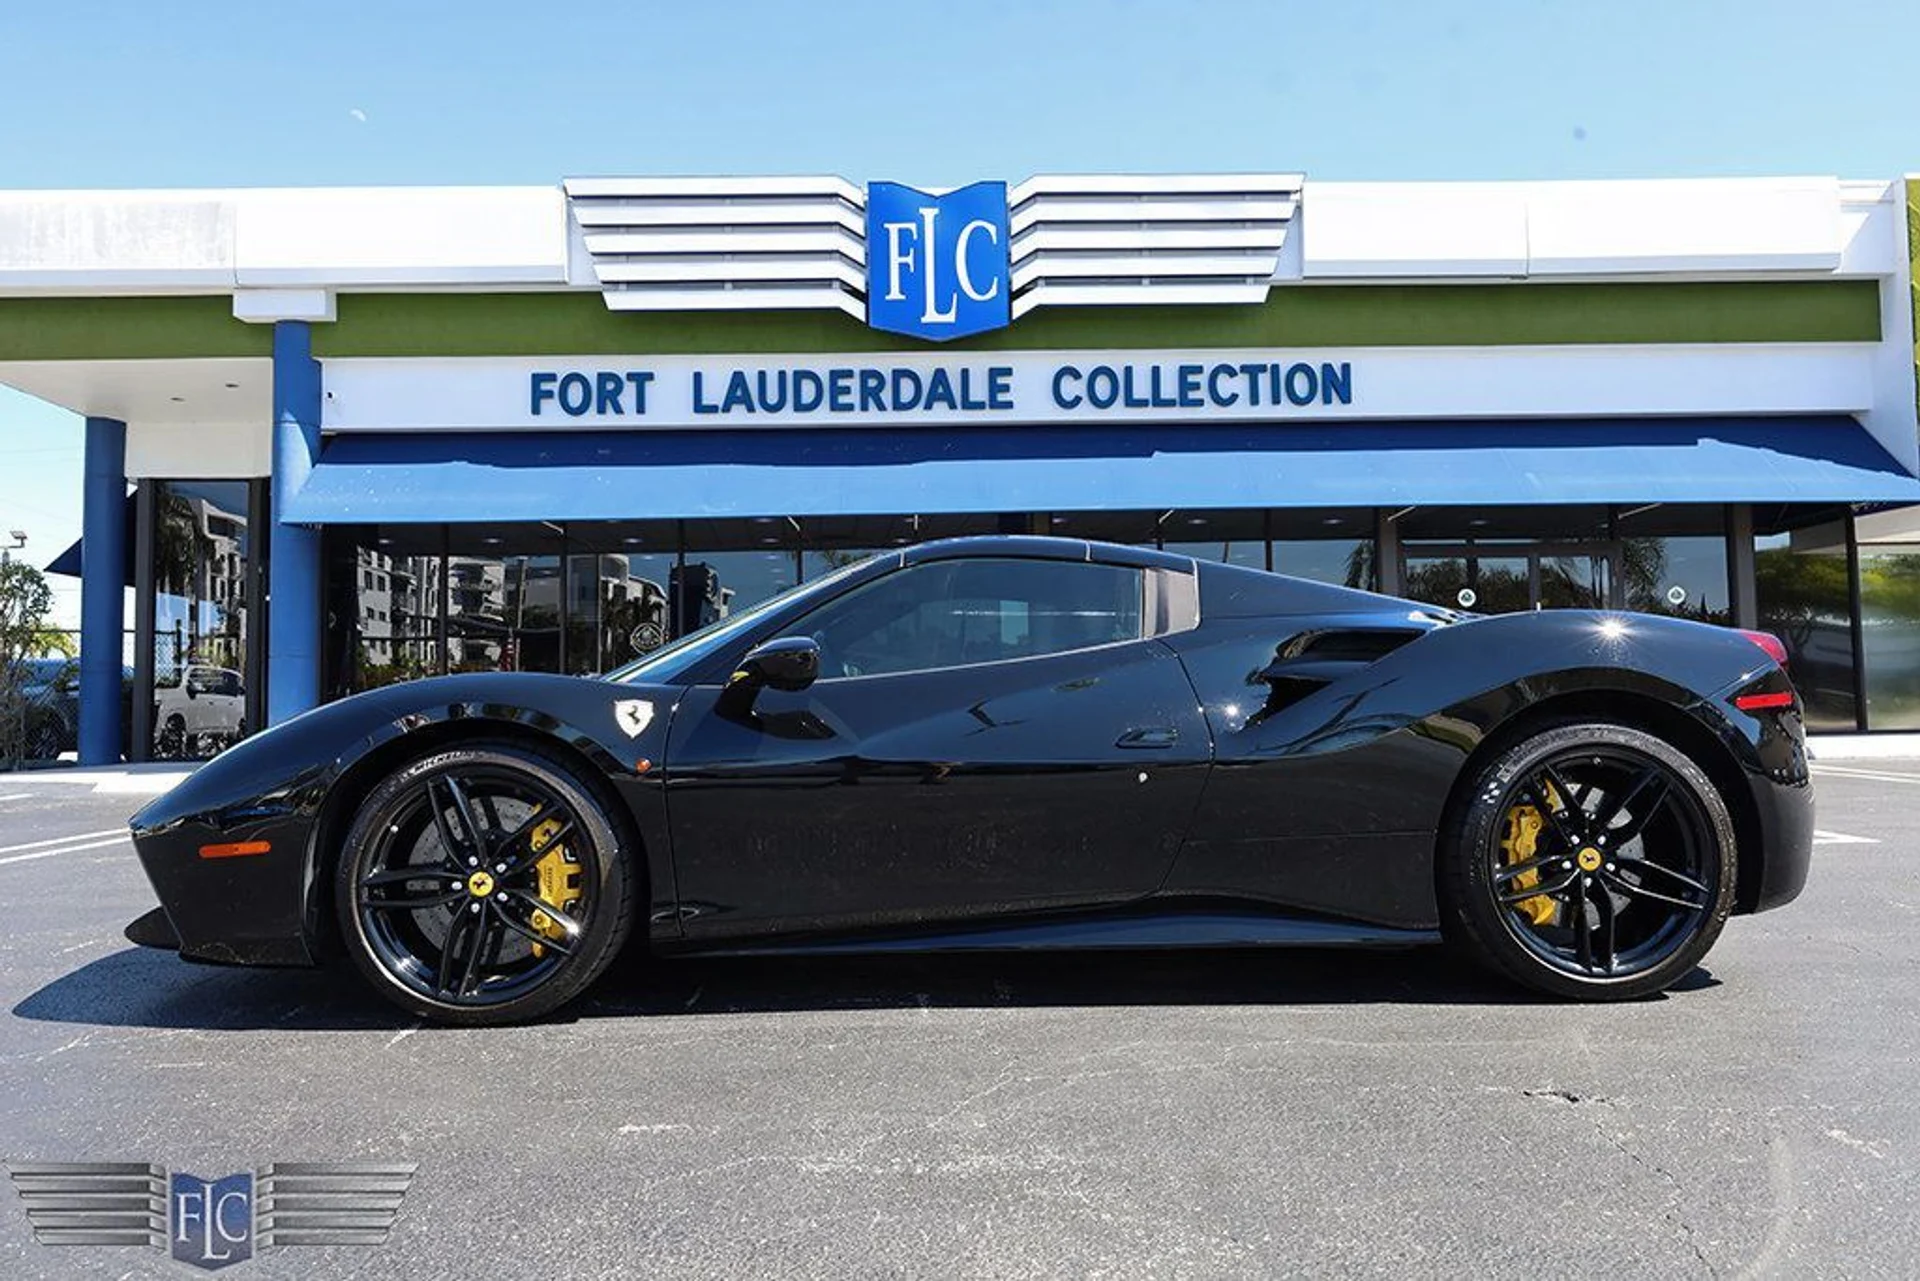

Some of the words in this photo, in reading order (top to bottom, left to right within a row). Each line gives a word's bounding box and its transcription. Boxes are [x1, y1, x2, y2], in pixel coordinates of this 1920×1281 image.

[883, 207, 998, 323] FLC
[530, 372, 655, 417] FORT
[692, 367, 1014, 414] LAUDERDALE
[1052, 362, 1352, 410] COLLECTION
